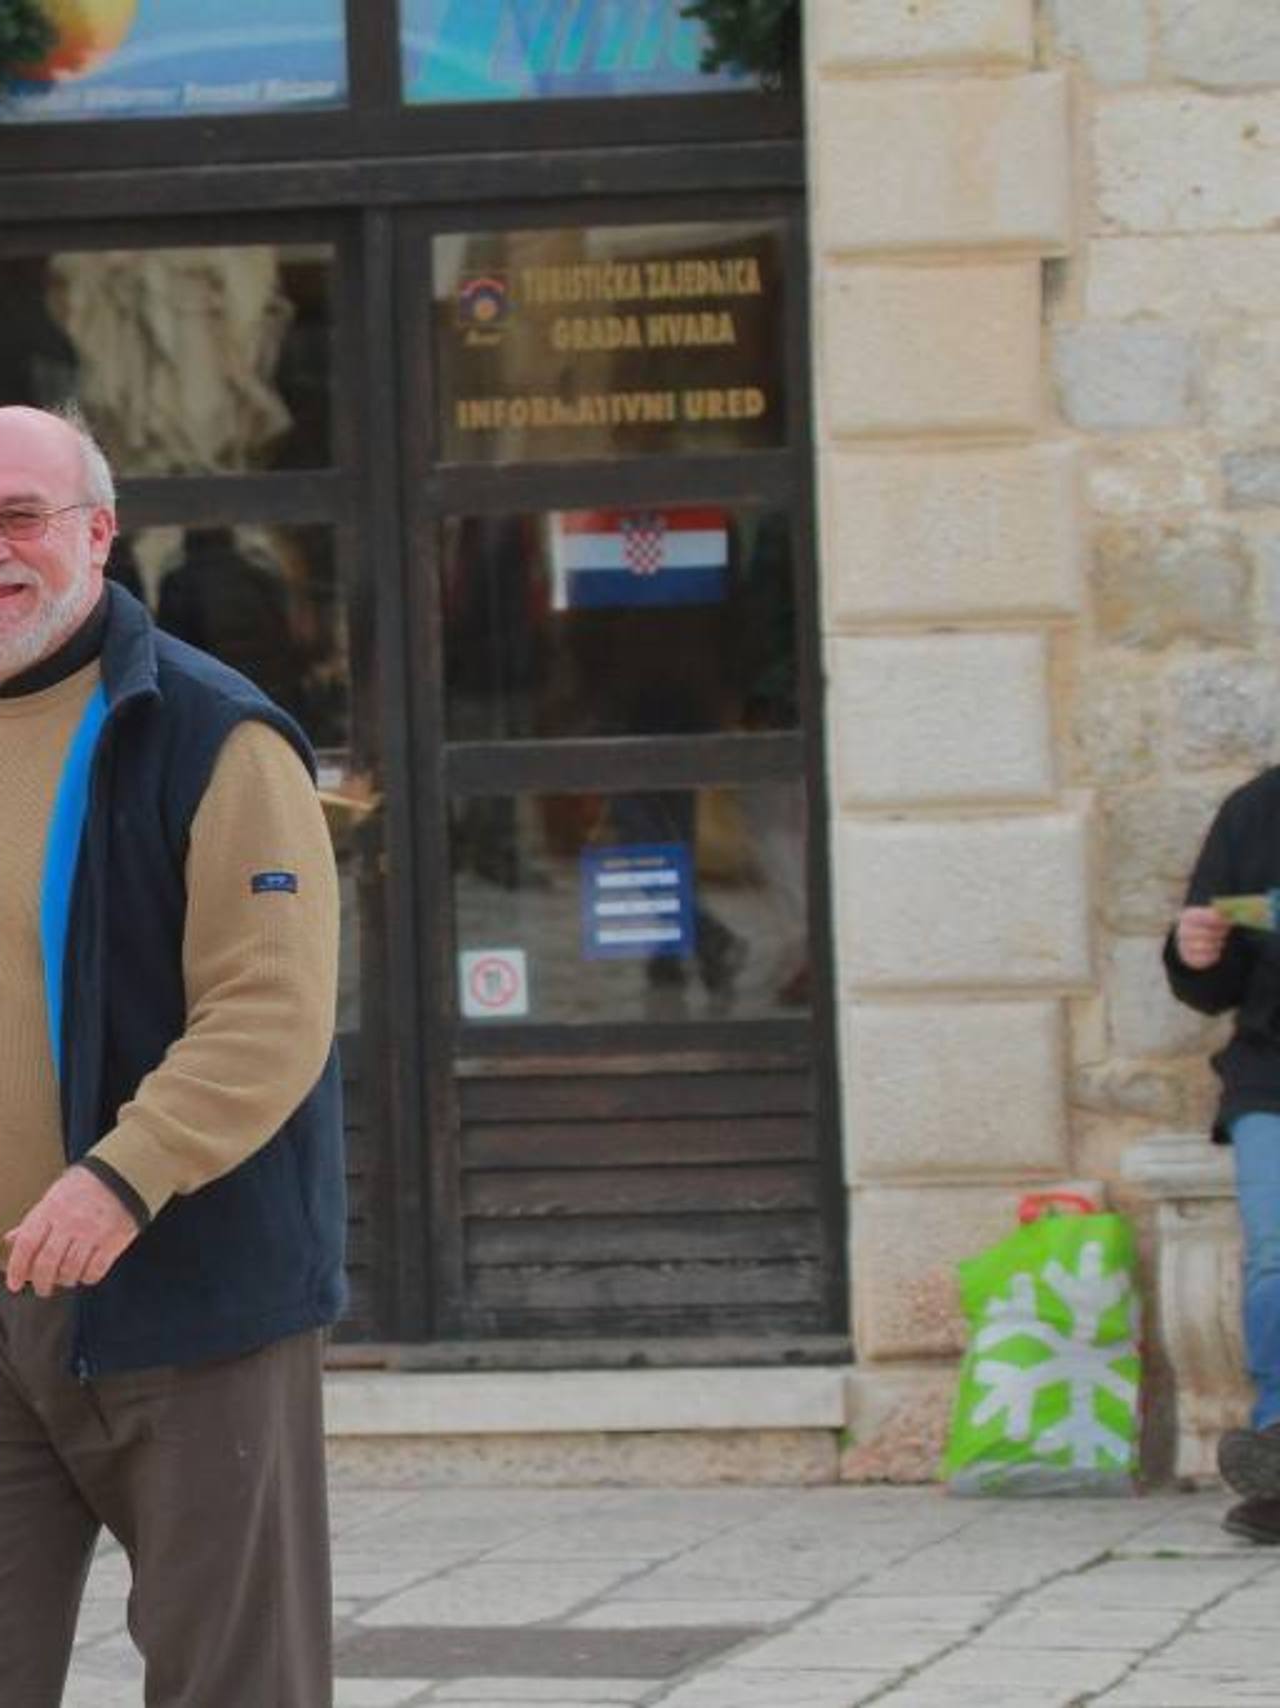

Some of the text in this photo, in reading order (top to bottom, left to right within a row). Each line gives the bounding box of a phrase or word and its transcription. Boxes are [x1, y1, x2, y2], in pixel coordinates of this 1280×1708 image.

[553, 312, 736, 350] GRADA HVARA
[684, 387, 765, 421] URED
